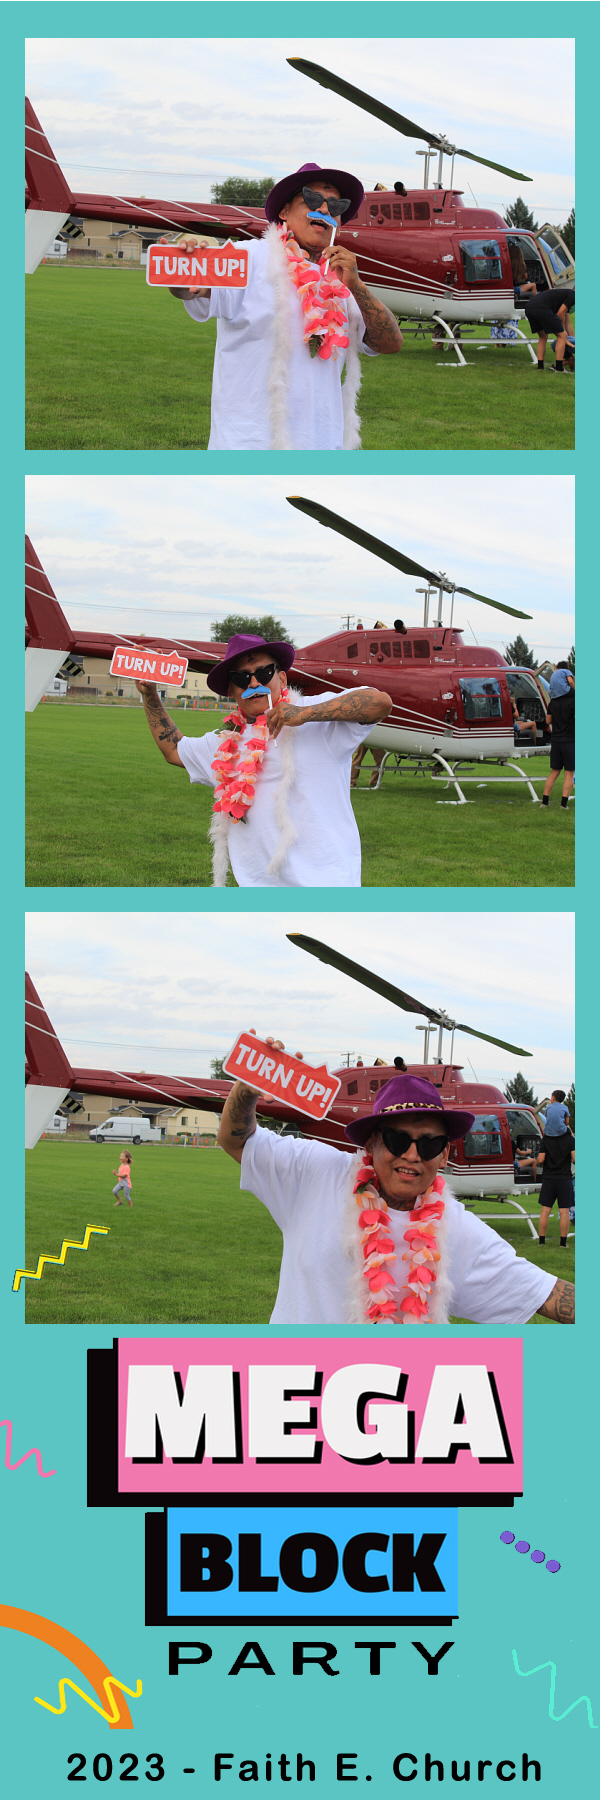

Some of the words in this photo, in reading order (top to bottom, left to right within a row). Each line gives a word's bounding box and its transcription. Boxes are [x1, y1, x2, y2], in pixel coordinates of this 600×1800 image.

[152, 256, 207, 276] TURN
[214, 258, 245, 278] UP!
[117, 654, 156, 674] TURN
[160, 662, 184, 679] UP!
[235, 1043, 295, 1089] TURN
[296, 1074, 333, 1108] UP!
